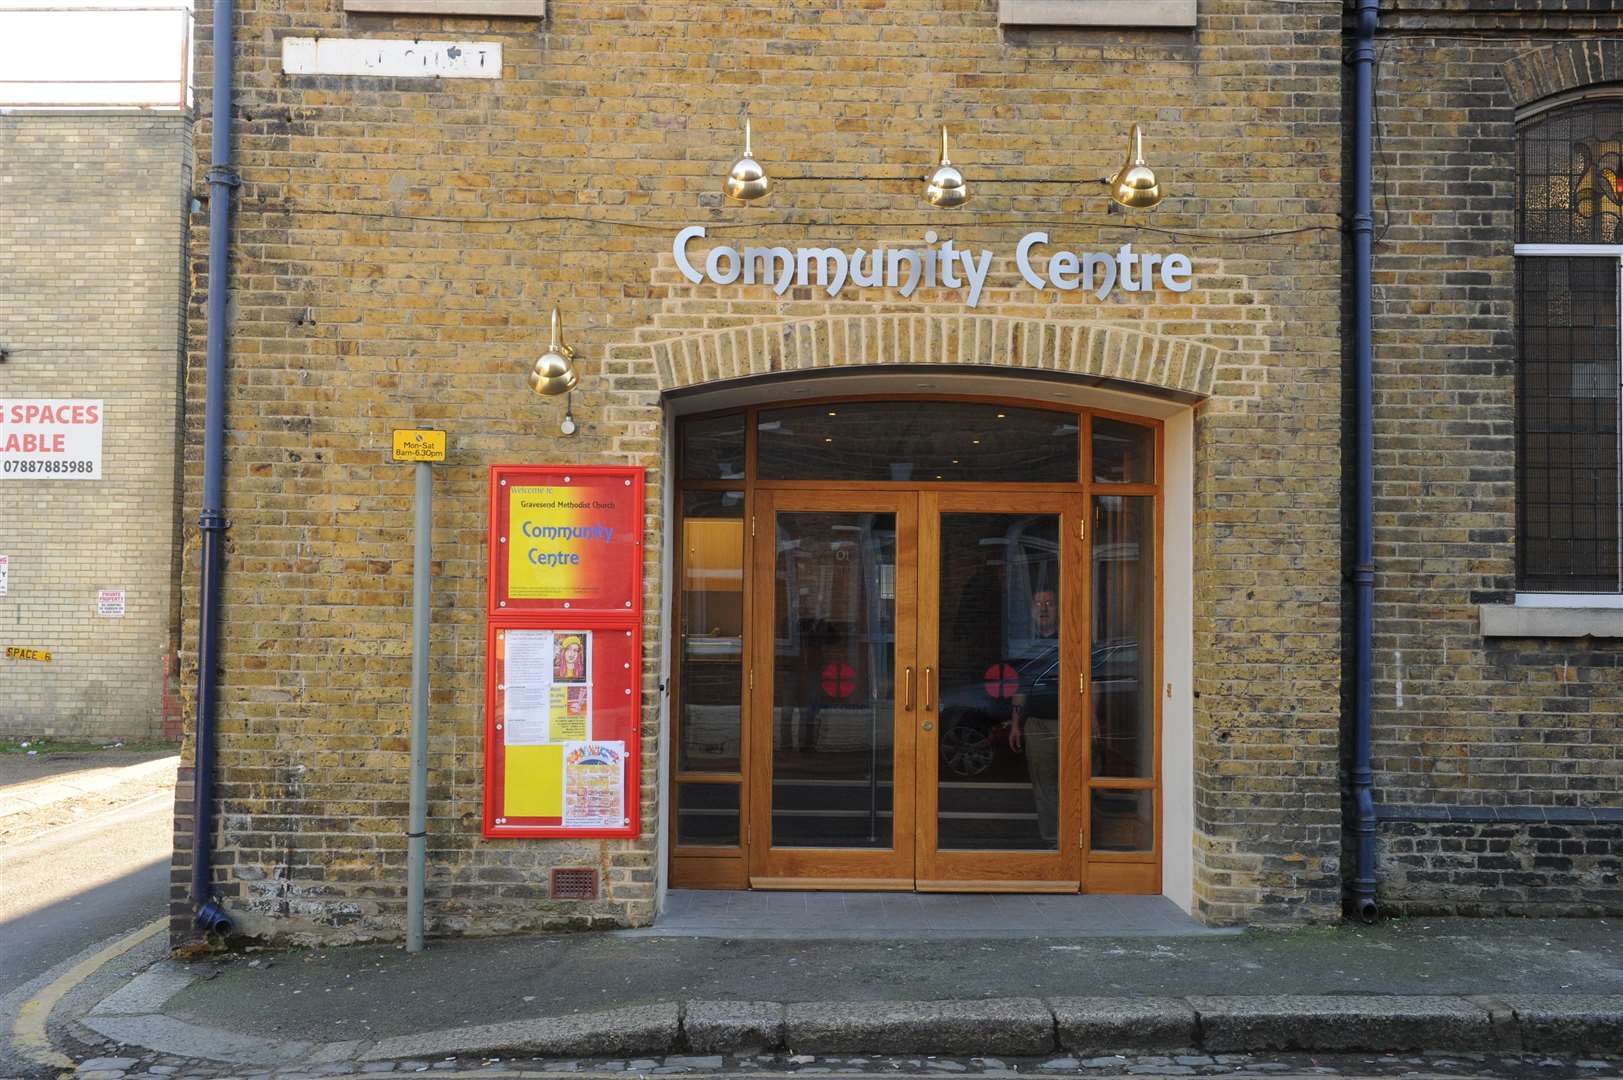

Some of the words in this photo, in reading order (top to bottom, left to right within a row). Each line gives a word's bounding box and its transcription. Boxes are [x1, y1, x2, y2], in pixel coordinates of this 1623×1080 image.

[673, 226, 993, 308] Community
[1015, 231, 1193, 301] Centre
[10, 404, 99, 424] SPACES
[3, 460, 94, 473] 07887885988
[520, 500, 556, 509] Gravesend
[557, 501, 591, 509] Methodist
[592, 501, 615, 509] Church
[522, 520, 614, 544] Community
[528, 547, 580, 567] Centre
[6, 647, 38, 659] SPACE
[44, 652, 52, 661] 6
